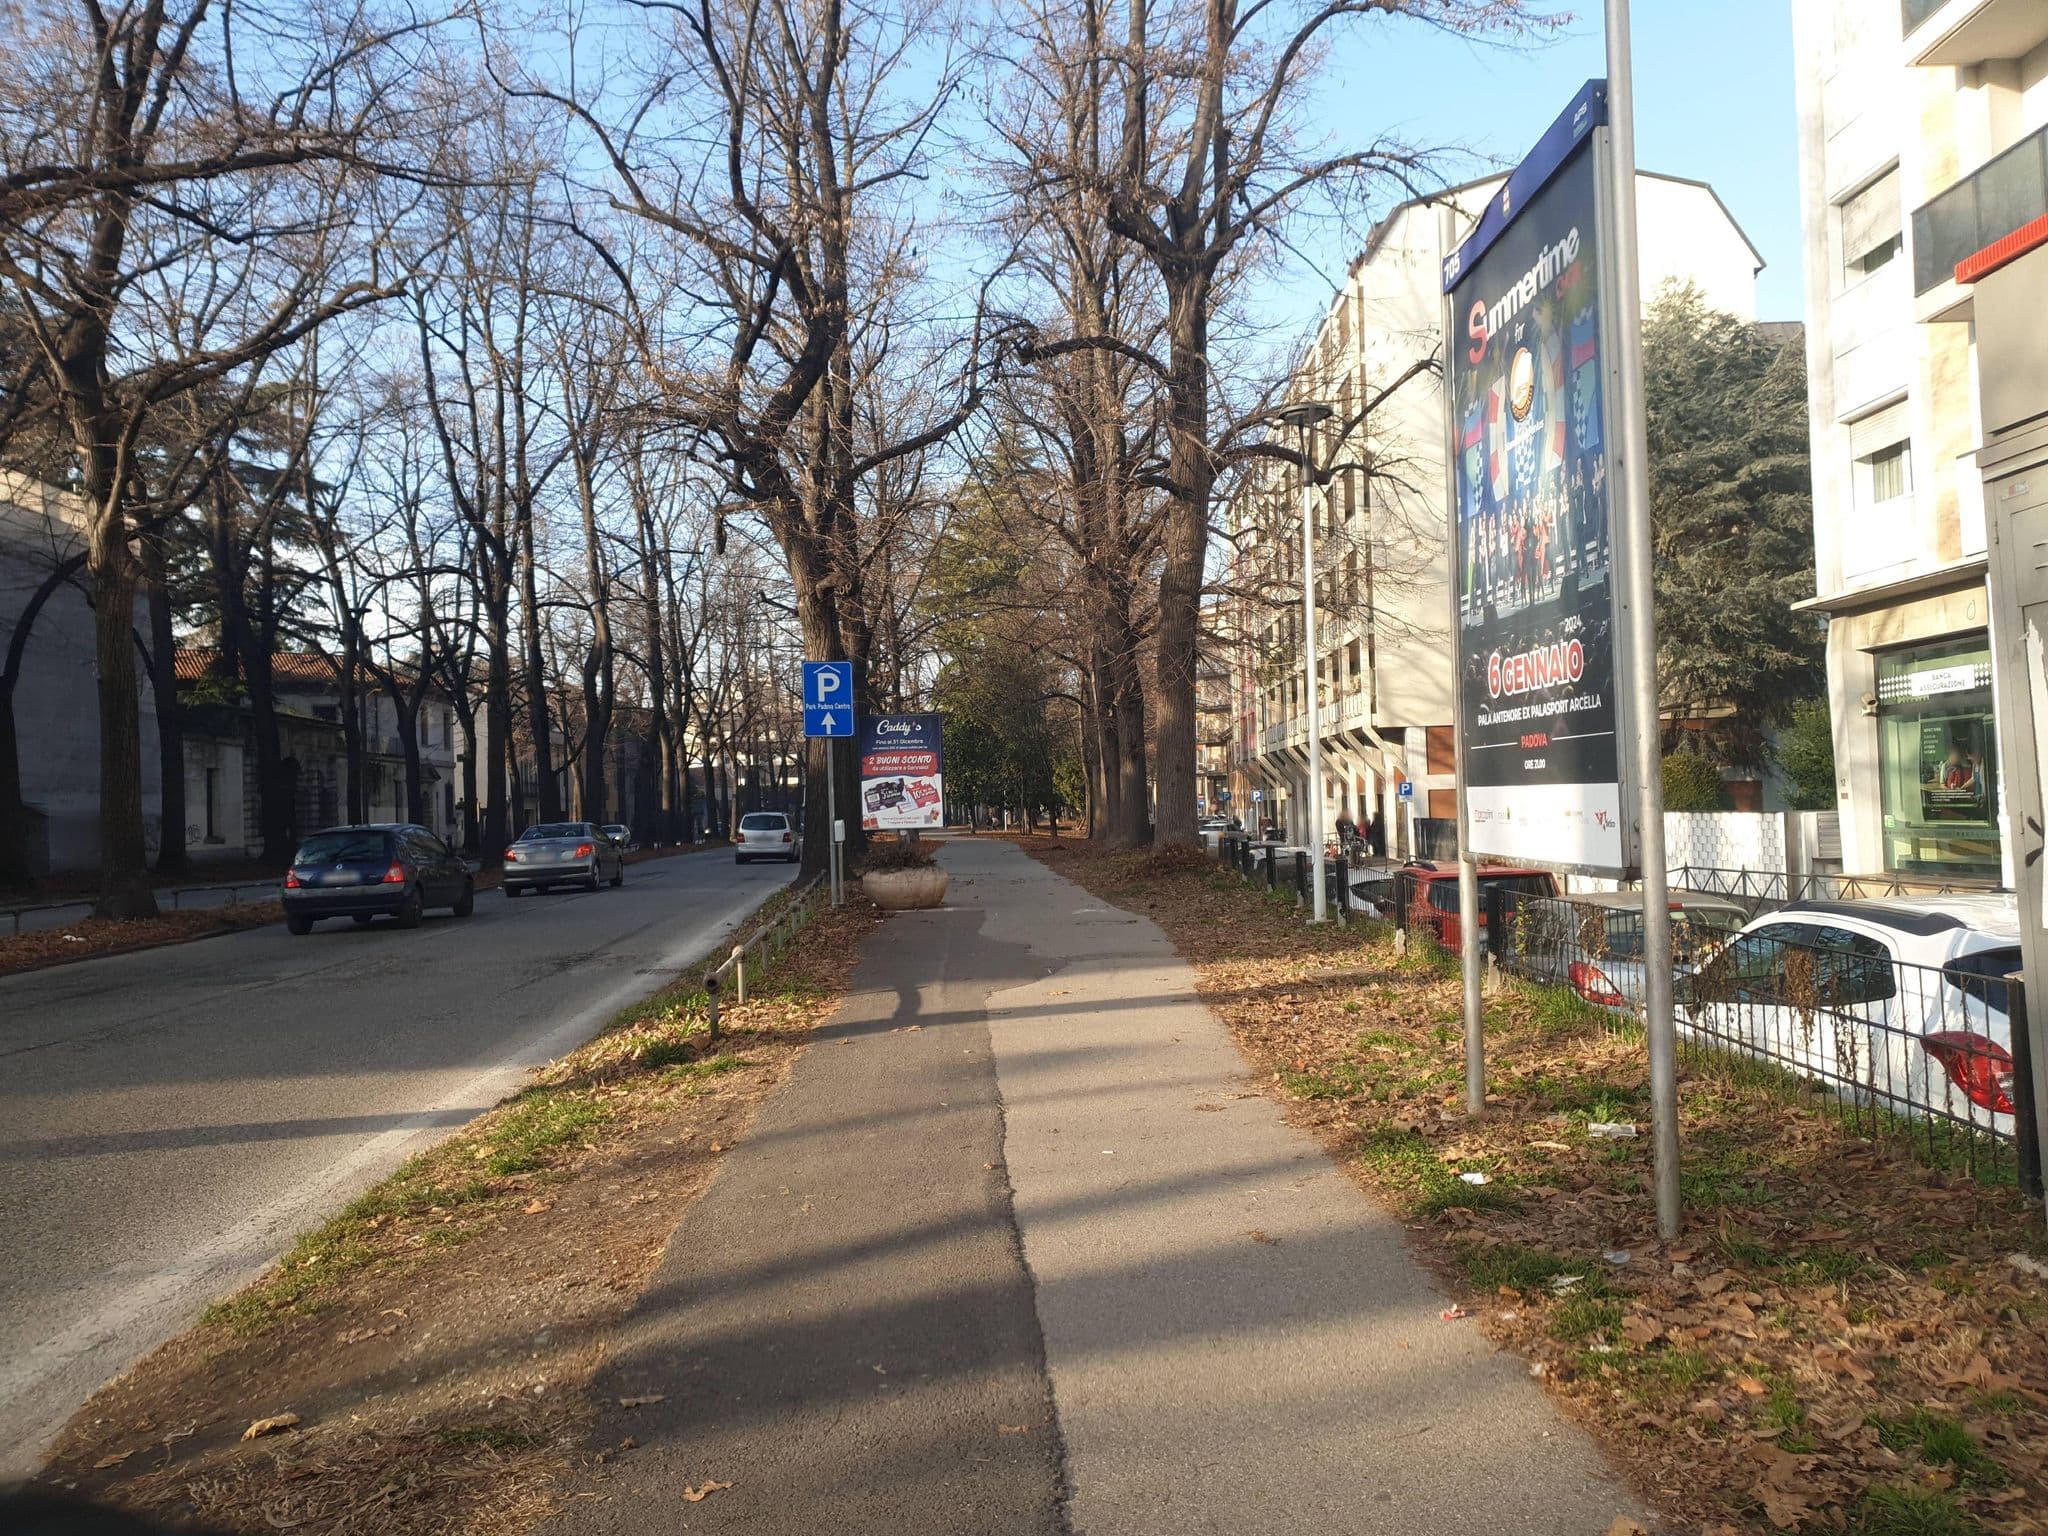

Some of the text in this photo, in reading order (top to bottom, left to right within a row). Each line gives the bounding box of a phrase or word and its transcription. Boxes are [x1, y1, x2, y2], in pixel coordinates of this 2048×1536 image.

[1444, 253, 1460, 285] 705
[1468, 226, 1580, 365] Summertime
[1514, 322, 1525, 345] for
[1563, 614, 1583, 633] 2024
[1488, 638, 1584, 699] 6 GENNAIO
[818, 672, 840, 702] P
[1477, 693, 1602, 727] PALA ANTENORE EX PALASPORT ARCELLA
[876, 719, 922, 736] Caddy's
[1520, 732, 1548, 749] PADOVA
[869, 755, 932, 765] 2 BUONI SCONTO
[1524, 759, 1534, 770] ORE
[1253, 791, 1261, 801] P
[1401, 783, 1410, 794] P
